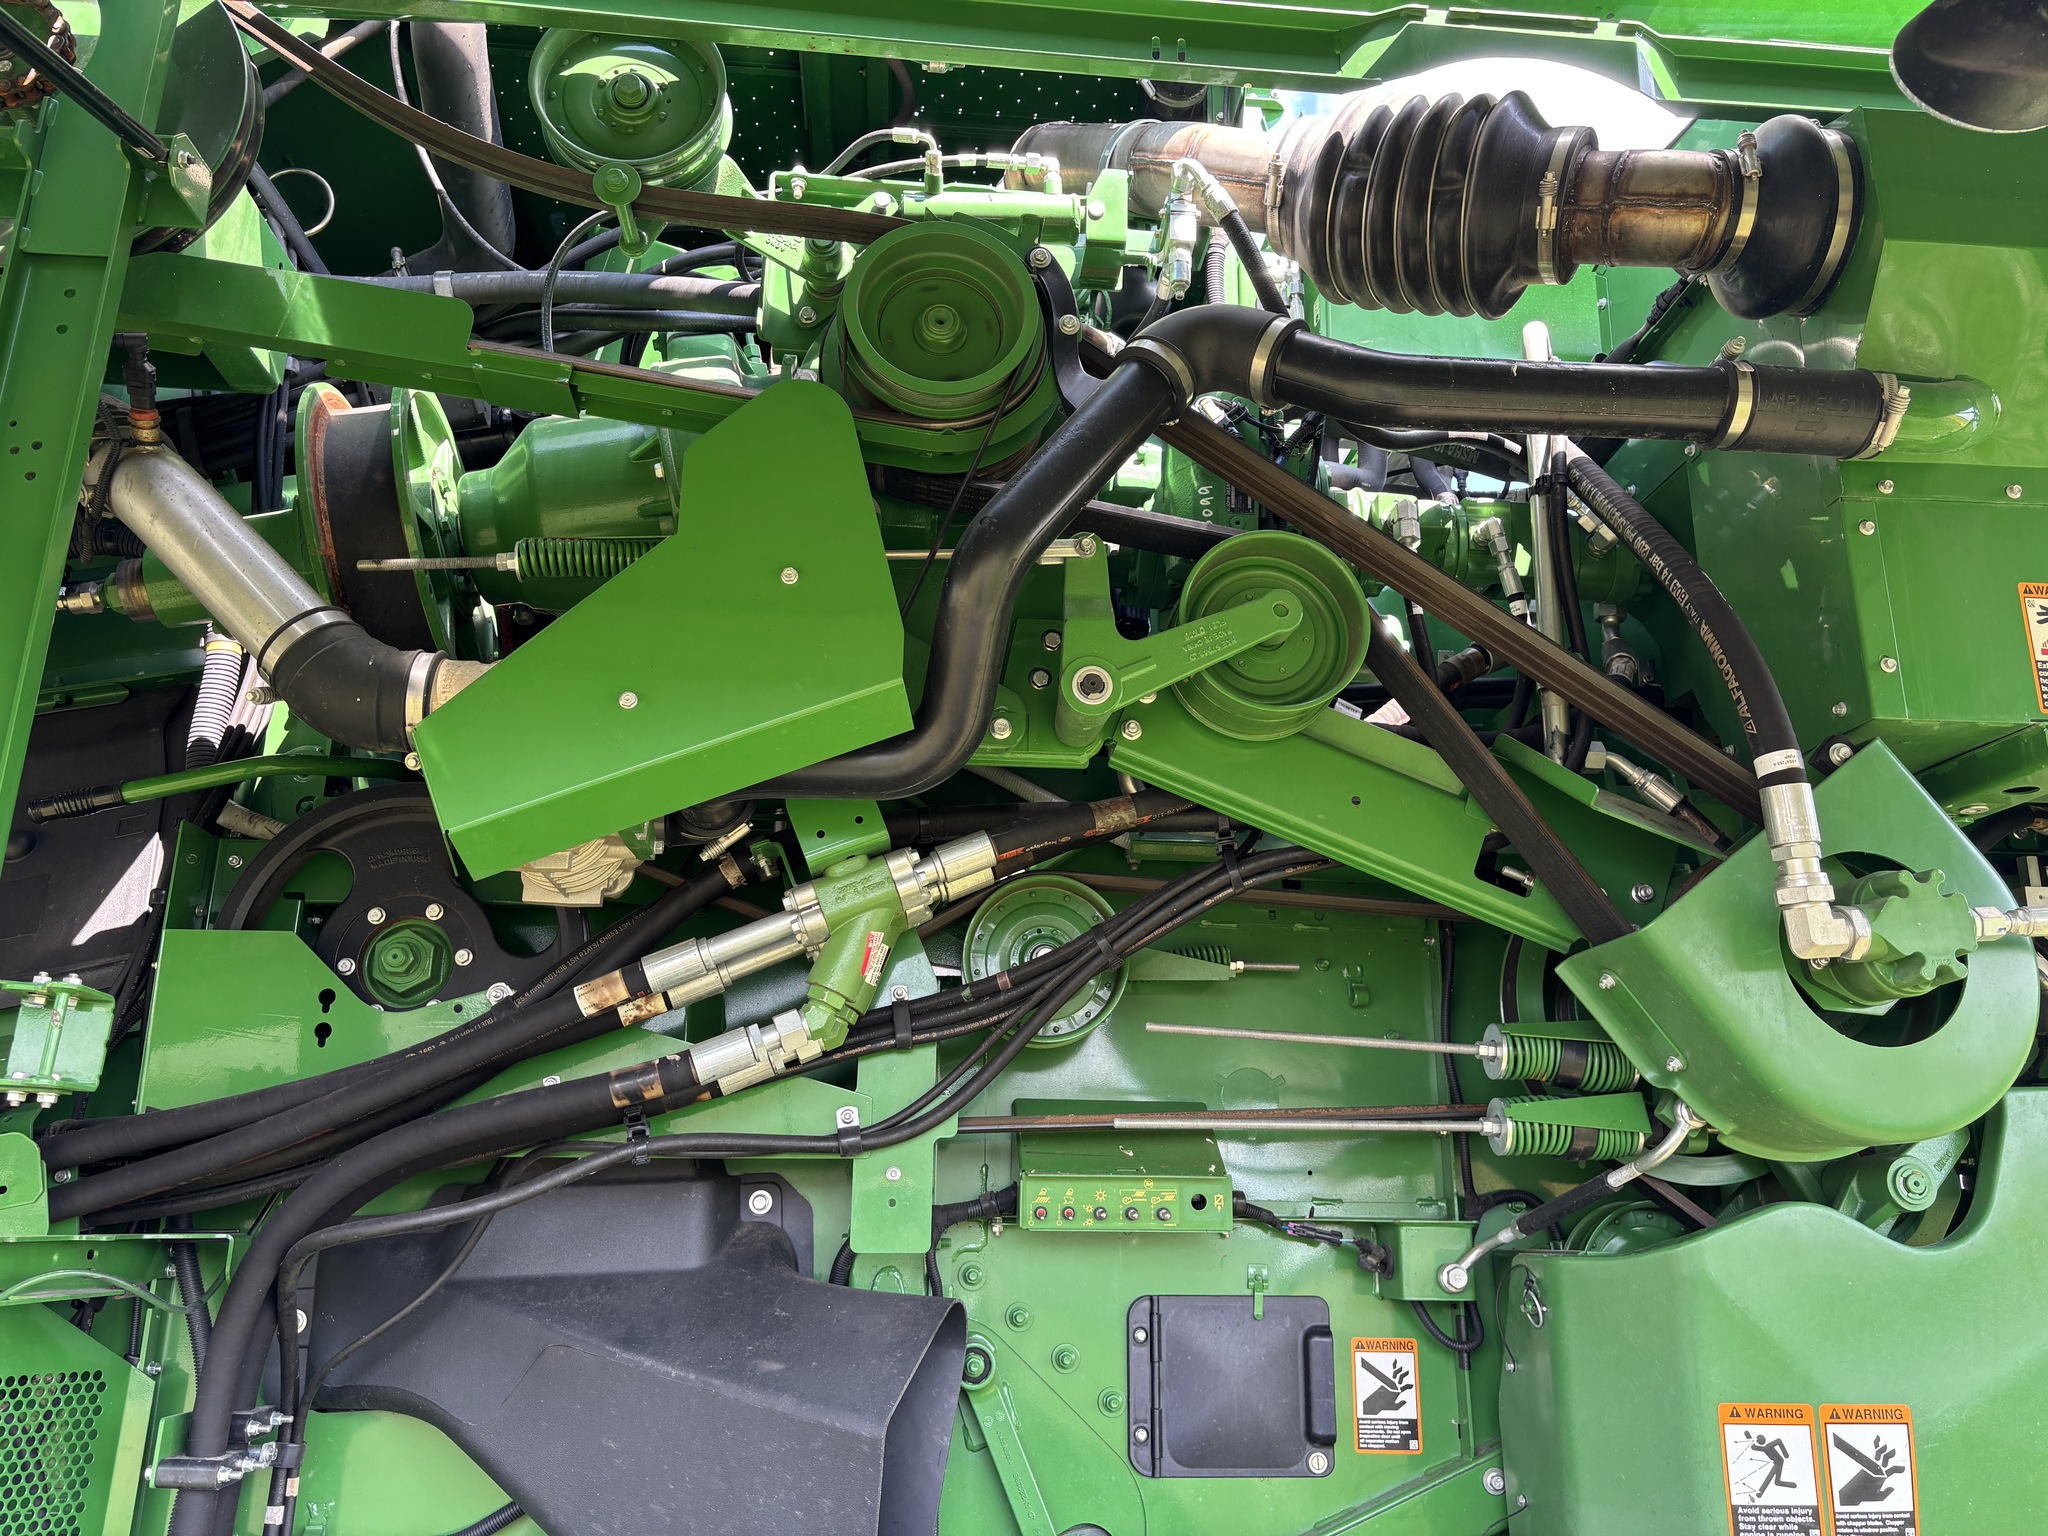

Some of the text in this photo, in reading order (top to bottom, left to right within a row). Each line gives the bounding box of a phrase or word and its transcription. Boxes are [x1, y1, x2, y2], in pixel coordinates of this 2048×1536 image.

[1685, 603, 1700, 624] ITALY
[1212, 627, 1232, 639] MADE
[1181, 639, 1203, 652] CHINA
[1699, 619, 1752, 719] ALFAGOMMA
[1366, 1340, 1414, 1350] WARNING
[1745, 1408, 1804, 1419] WARNING
[1842, 1408, 1903, 1420] WARNING
[1791, 1507, 1813, 1515] injury
[1786, 1515, 1815, 1523] objects.
[1739, 1523, 1756, 1532] Stay
